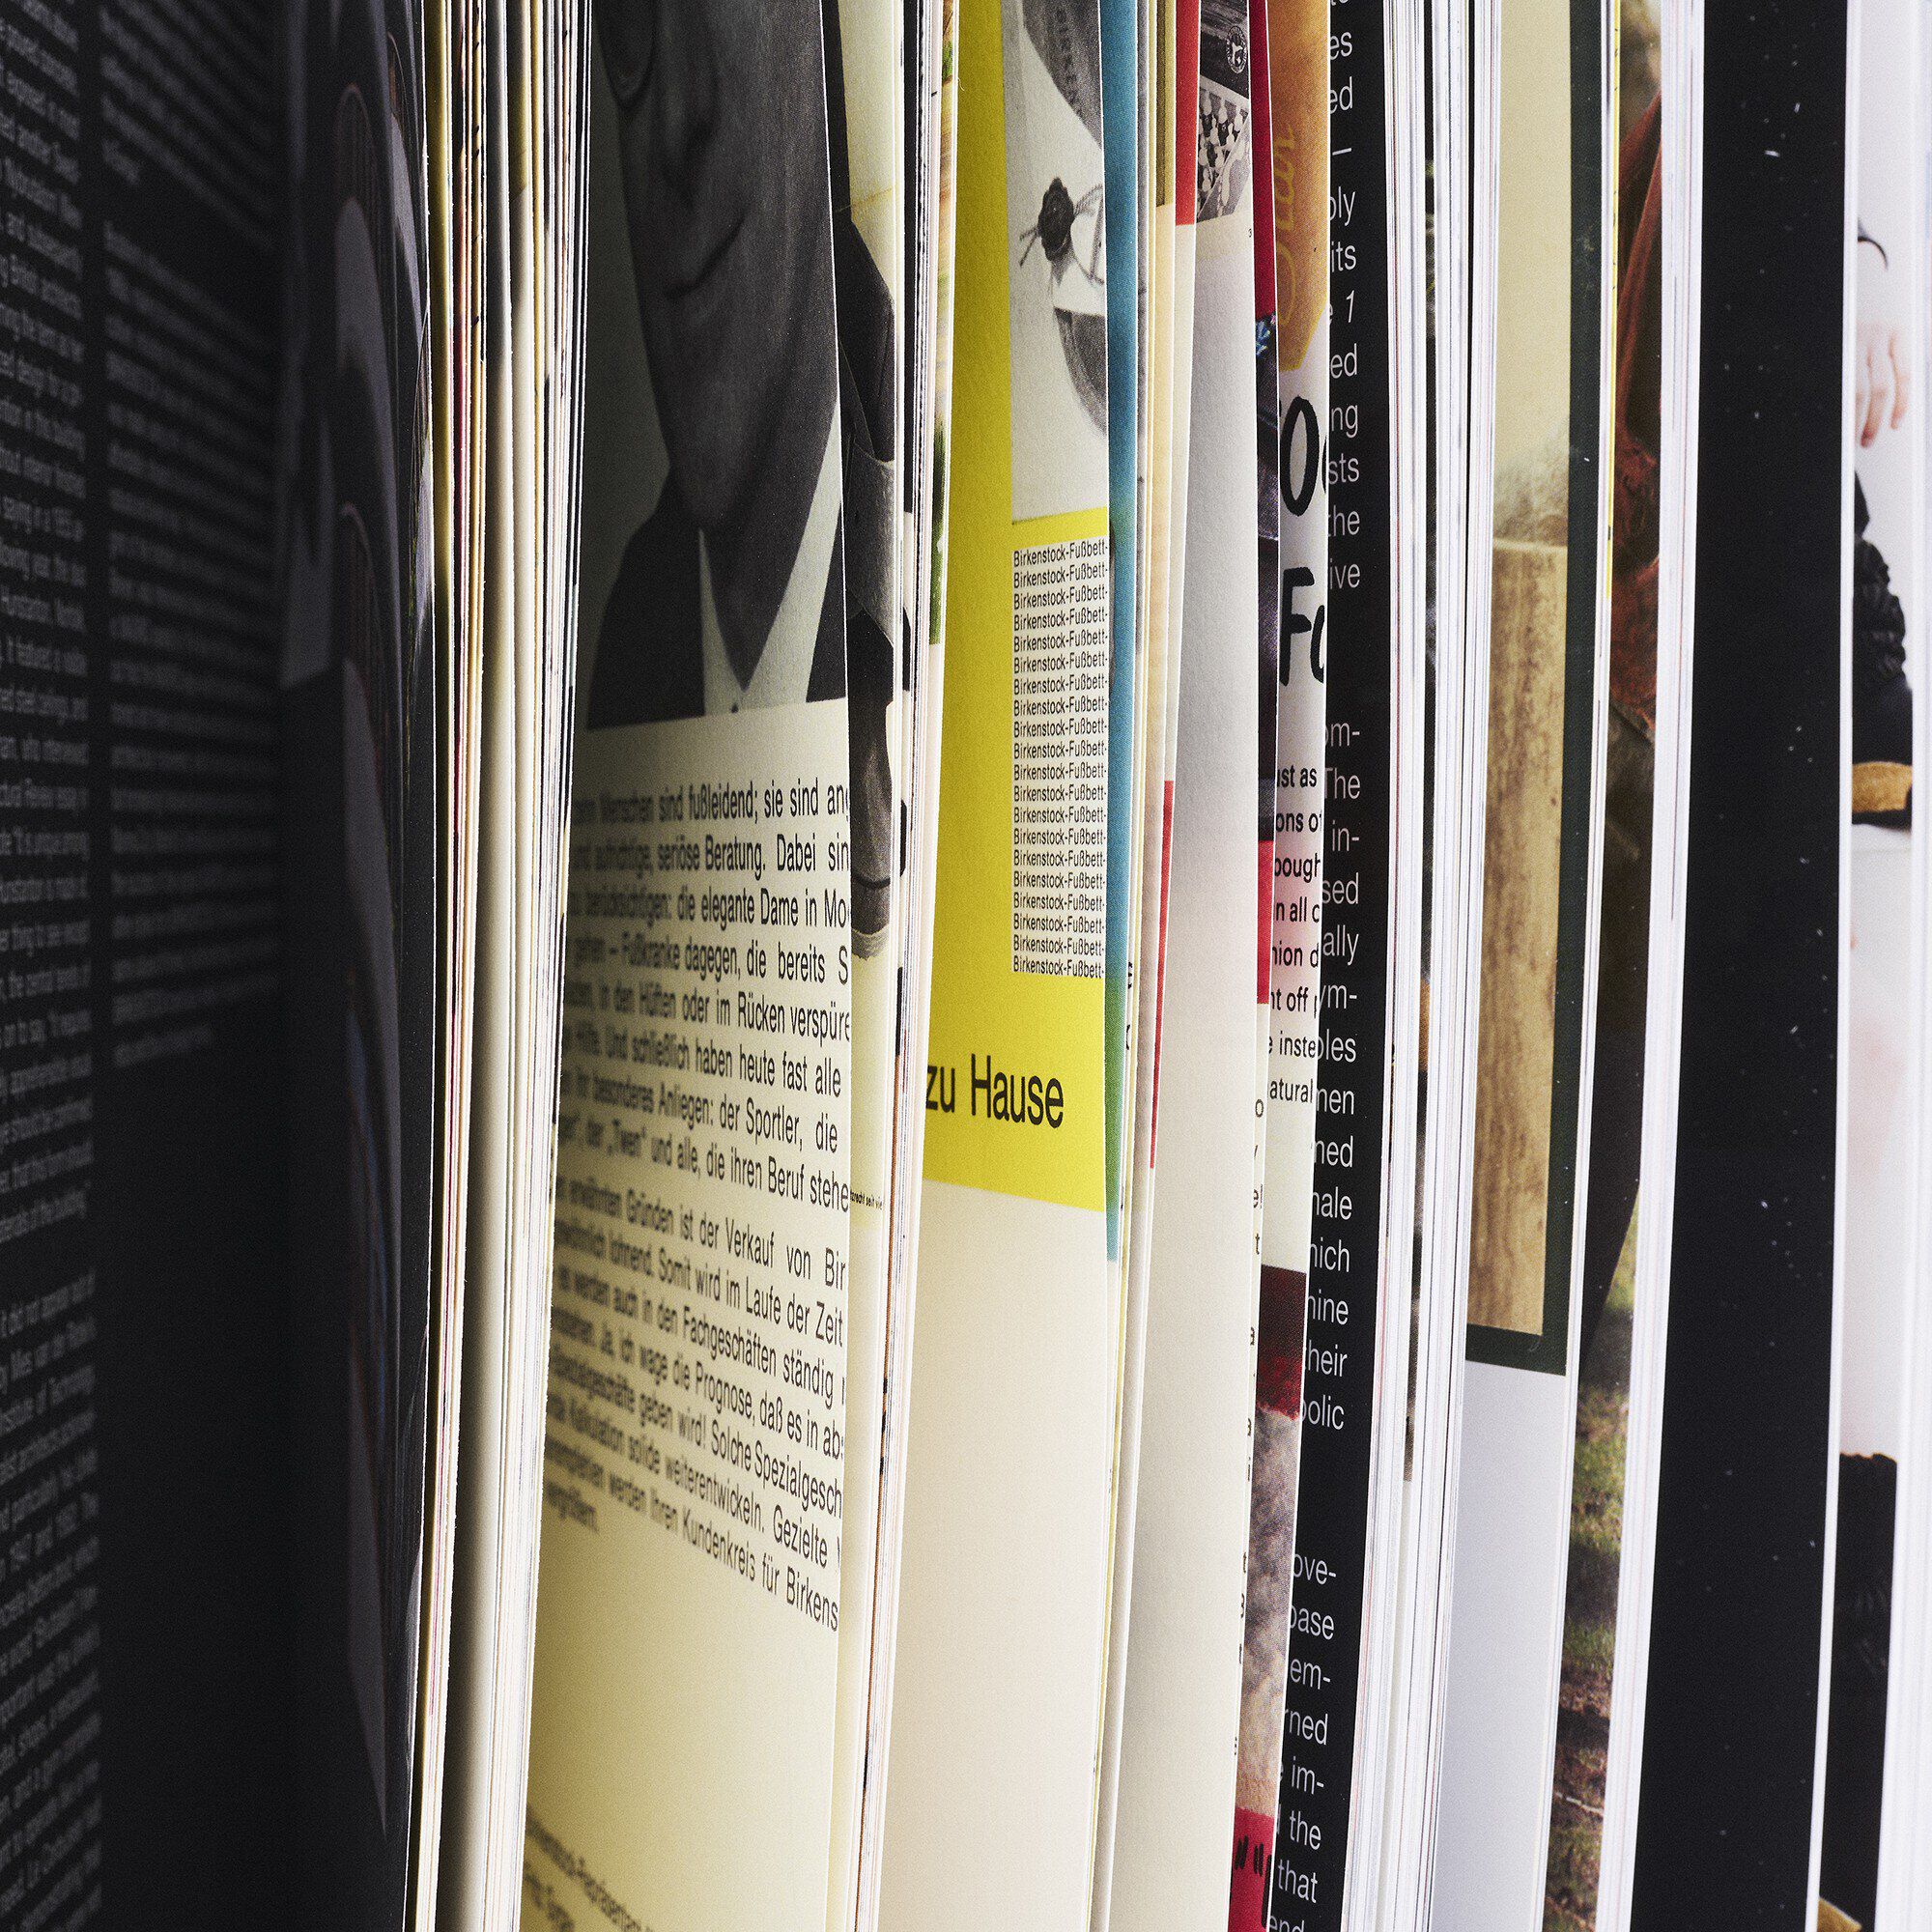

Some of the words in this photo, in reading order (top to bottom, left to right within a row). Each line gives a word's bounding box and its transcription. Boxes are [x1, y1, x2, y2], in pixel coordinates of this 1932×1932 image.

[1330, 31, 1352, 60] es
[1331, 242, 1356, 272] its
[1330, 343, 1357, 379] ed
[1331, 404, 1358, 438] ng
[1329, 453, 1360, 484] sts
[1013, 539, 1108, 567] Birkenstock-Fußbett-
[1013, 561, 1108, 588] Birkenstock-Fußbett-
[1330, 558, 1360, 589] ive
[1013, 583, 1108, 610] Birkenstock-Fußbett-
[1013, 606, 1107, 631] Birkenstock-Fußbett-
[1013, 628, 1107, 652] Birkenstock-Fußbett-
[1013, 651, 1107, 673] Birkenstock-Fußbett-
[1013, 673, 1107, 695] Birkenstock-Fußbett-
[1013, 696, 1107, 716] Birkenstock-Fußbett-
[1013, 718, 1106, 737] Birkenstock-Fußbett-
[1013, 740, 1106, 758] Birkenstock-Fußbett-
[1013, 762, 1106, 781] Birkenstock-Fußbett-
[1300, 768, 1317, 787] as
[689, 781, 758, 823] fußleidend;
[764, 780, 783, 818] sie
[790, 777, 818, 816] sind
[1013, 784, 1106, 802] Birkenstock-Fußbett-
[1013, 807, 1106, 823] Birkenstock-Fußbett-
[1013, 828, 1105, 844] Birkenstock-Fußbett-
[1332, 820, 1359, 851] in-
[704, 834, 766, 881] Beratung.
[777, 833, 816, 872] Dabei
[1013, 849, 1105, 867] Birkenstock-Fußbett-
[1013, 870, 1105, 889] Birkenstock-Fußbett-
[700, 886, 754, 931] elegante
[760, 888, 798, 925] Dame
[806, 889, 817, 927] in
[1013, 892, 1105, 911] Birkenstock-Fußbett-
[1290, 896, 1307, 922] all
[1013, 913, 1105, 933] Birkenstock-Fußbett-
[685, 936, 741, 982] dagegen,
[747, 939, 767, 979] die
[778, 941, 825, 984] bereits
[1013, 934, 1104, 955] Birkenstock-Fußbett-
[1323, 925, 1359, 965] ally
[1013, 955, 1104, 978] Birkenstock-Fußbett-
[682, 986, 710, 1023] oder
[717, 988, 730, 1027] im
[737, 990, 784, 1034] Rücken
[1287, 986, 1308, 1012] off
[696, 1038, 733, 1078] haben
[740, 1044, 776, 1086] heute
[782, 1051, 808, 1093] fast
[815, 1058, 841, 1097] alle
[926, 1065, 955, 1113] zu
[972, 1053, 1064, 1128] Hause
[1270, 1079, 1313, 1103] atural
[659, 1083, 714, 1130] Anliegen:
[720, 1094, 740, 1132] der
[746, 1096, 803, 1151] Sportler,
[815, 1112, 838, 1153] die
[677, 1137, 700, 1179] alle,
[706, 1143, 725, 1180] die
[731, 1147, 762, 1191] ihren
[768, 1156, 805, 1202] Beruf
[810, 1171, 848, 1212] stehe
[680, 1205, 694, 1241] ist
[700, 1210, 719, 1248] der
[725, 1217, 775, 1269] Verkauf
[786, 1245, 810, 1281] von
[825, 1247, 846, 1292] Bir
[659, 1247, 691, 1291] Somit
[696, 1260, 721, 1301] wird
[726, 1270, 740, 1310] im
[746, 1275, 781, 1324] Laufe
[786, 1293, 810, 1334] der
[815, 1301, 843, 1348] Zeit
[683, 1306, 777, 1378] Fachgeschäften
[782, 1350, 834, 1410] ständig
[1305, 1340, 1348, 1377] heir
[673, 1353, 691, 1391] die
[696, 1360, 755, 1427] Prognose,
[759, 1390, 782, 1435] daß
[786, 1410, 802, 1443] es
[808, 1409, 818, 1451] in
[678, 1408, 706, 1449] wird!
[712, 1419, 752, 1471] Solche
[754, 1439, 841, 1519] Spezialgesch
[666, 1451, 764, 1533] weiterentwickeln.
[773, 1504, 827, 1568] Gezielte
[682, 1508, 755, 1581] Kundenkreis
[762, 1552, 781, 1595] für
[786, 1567, 838, 1632] Birkens
[1291, 1659, 1330, 1690] em-
[1292, 1756, 1323, 1795] im-
[1290, 1810, 1321, 1850] the
[1277, 1860, 1318, 1903] that
